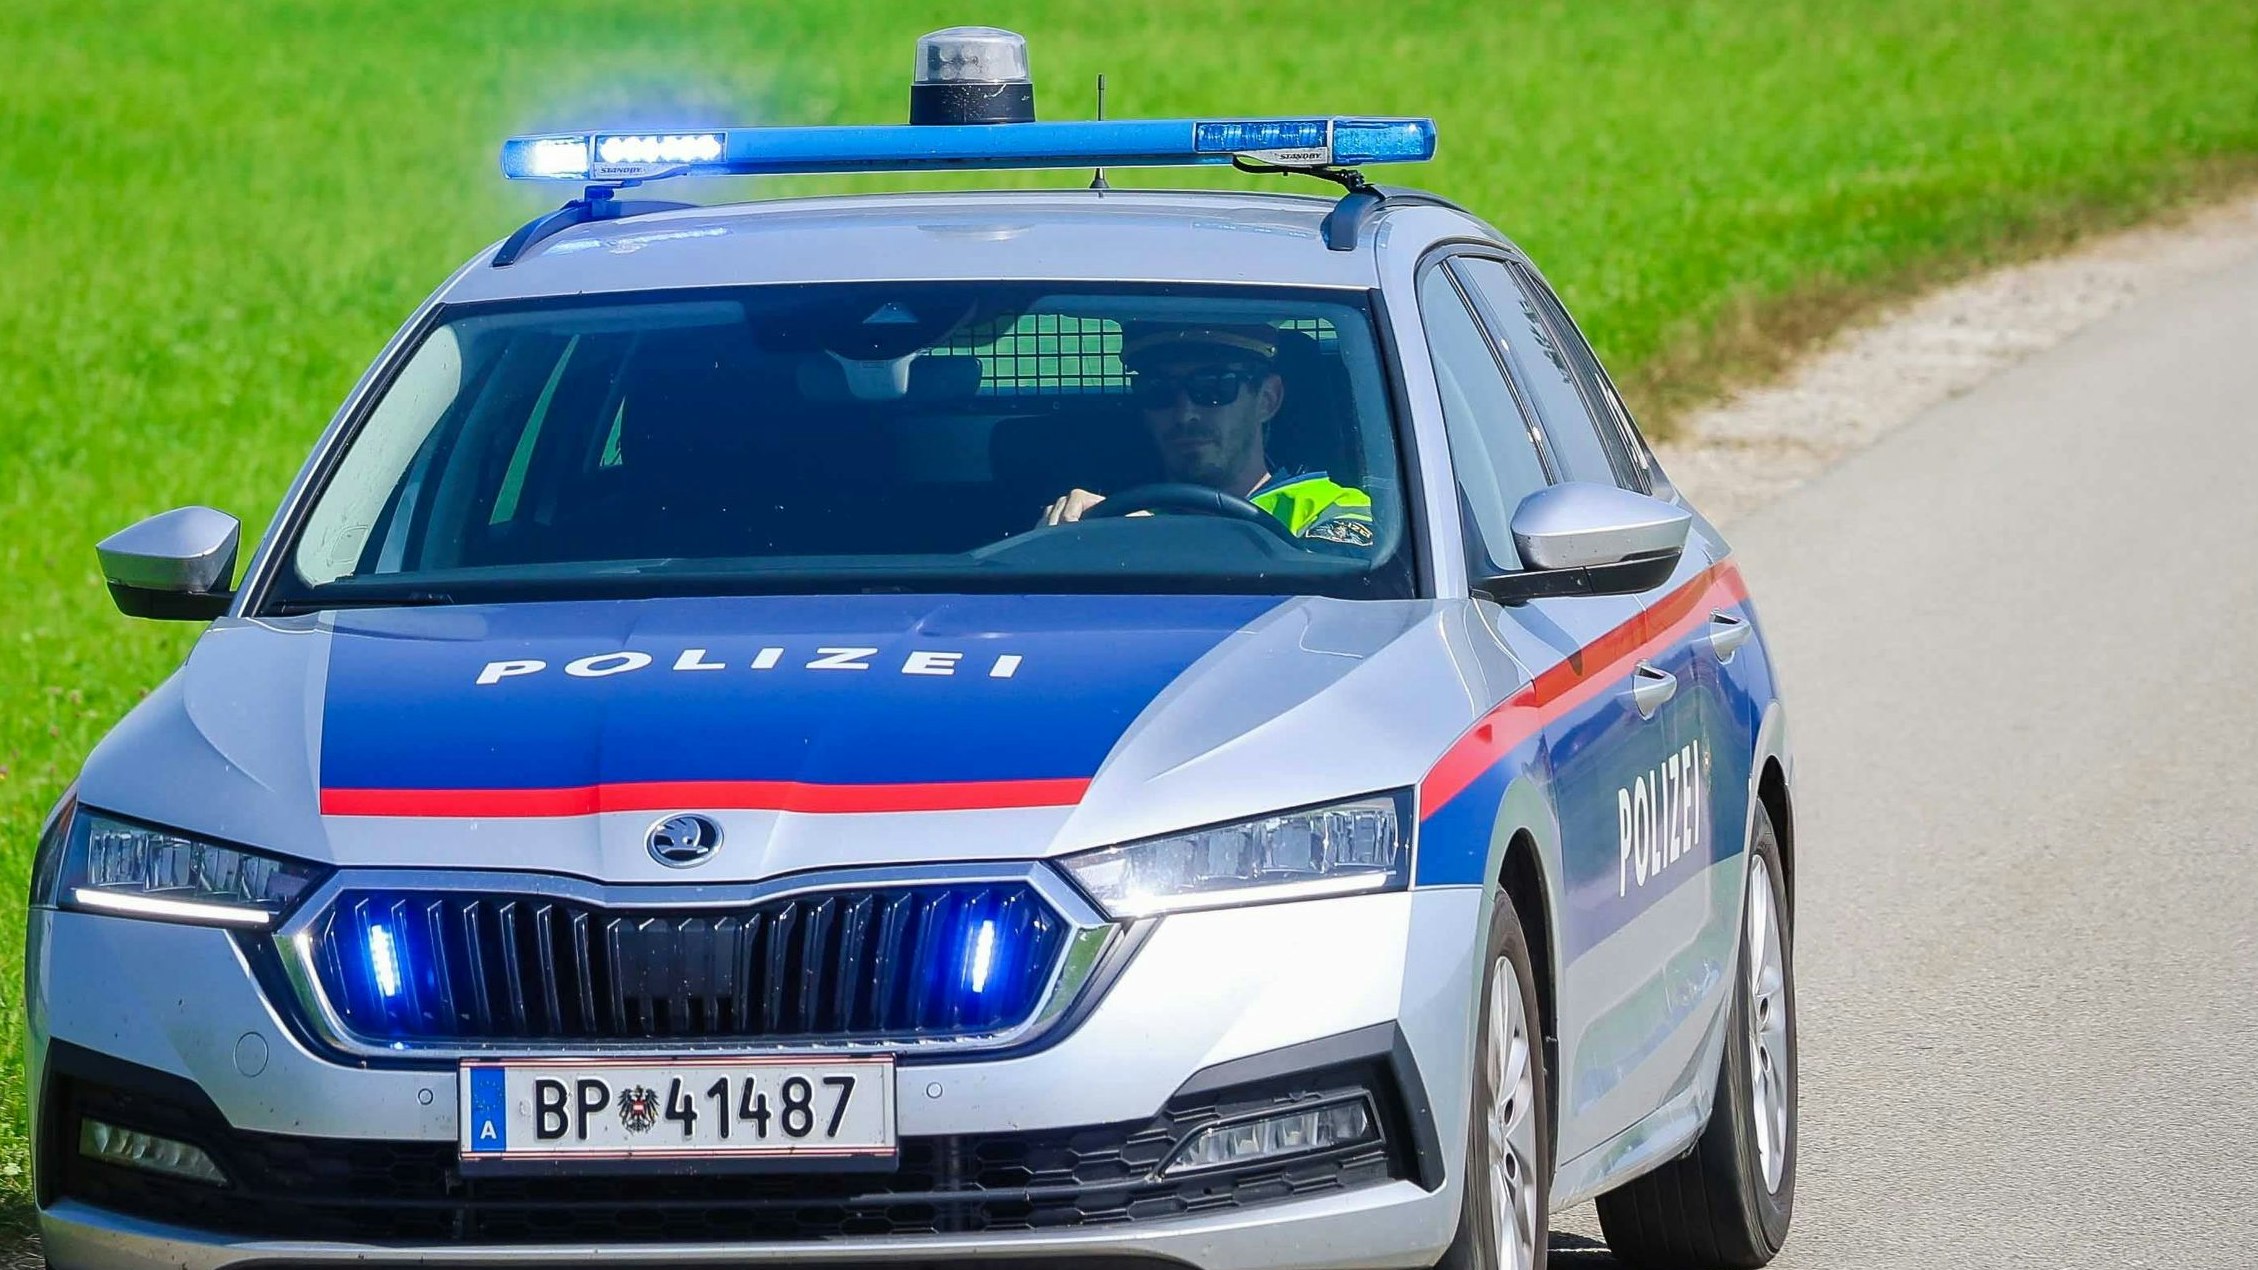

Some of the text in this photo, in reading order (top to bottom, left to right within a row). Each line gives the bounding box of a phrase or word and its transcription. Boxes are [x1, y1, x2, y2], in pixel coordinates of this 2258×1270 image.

[475, 647, 1023, 685] POLIZEI
[1617, 739, 1700, 898] POLIZEI
[480, 1120, 497, 1140] A
[535, 1076, 857, 1140] BP 41487
